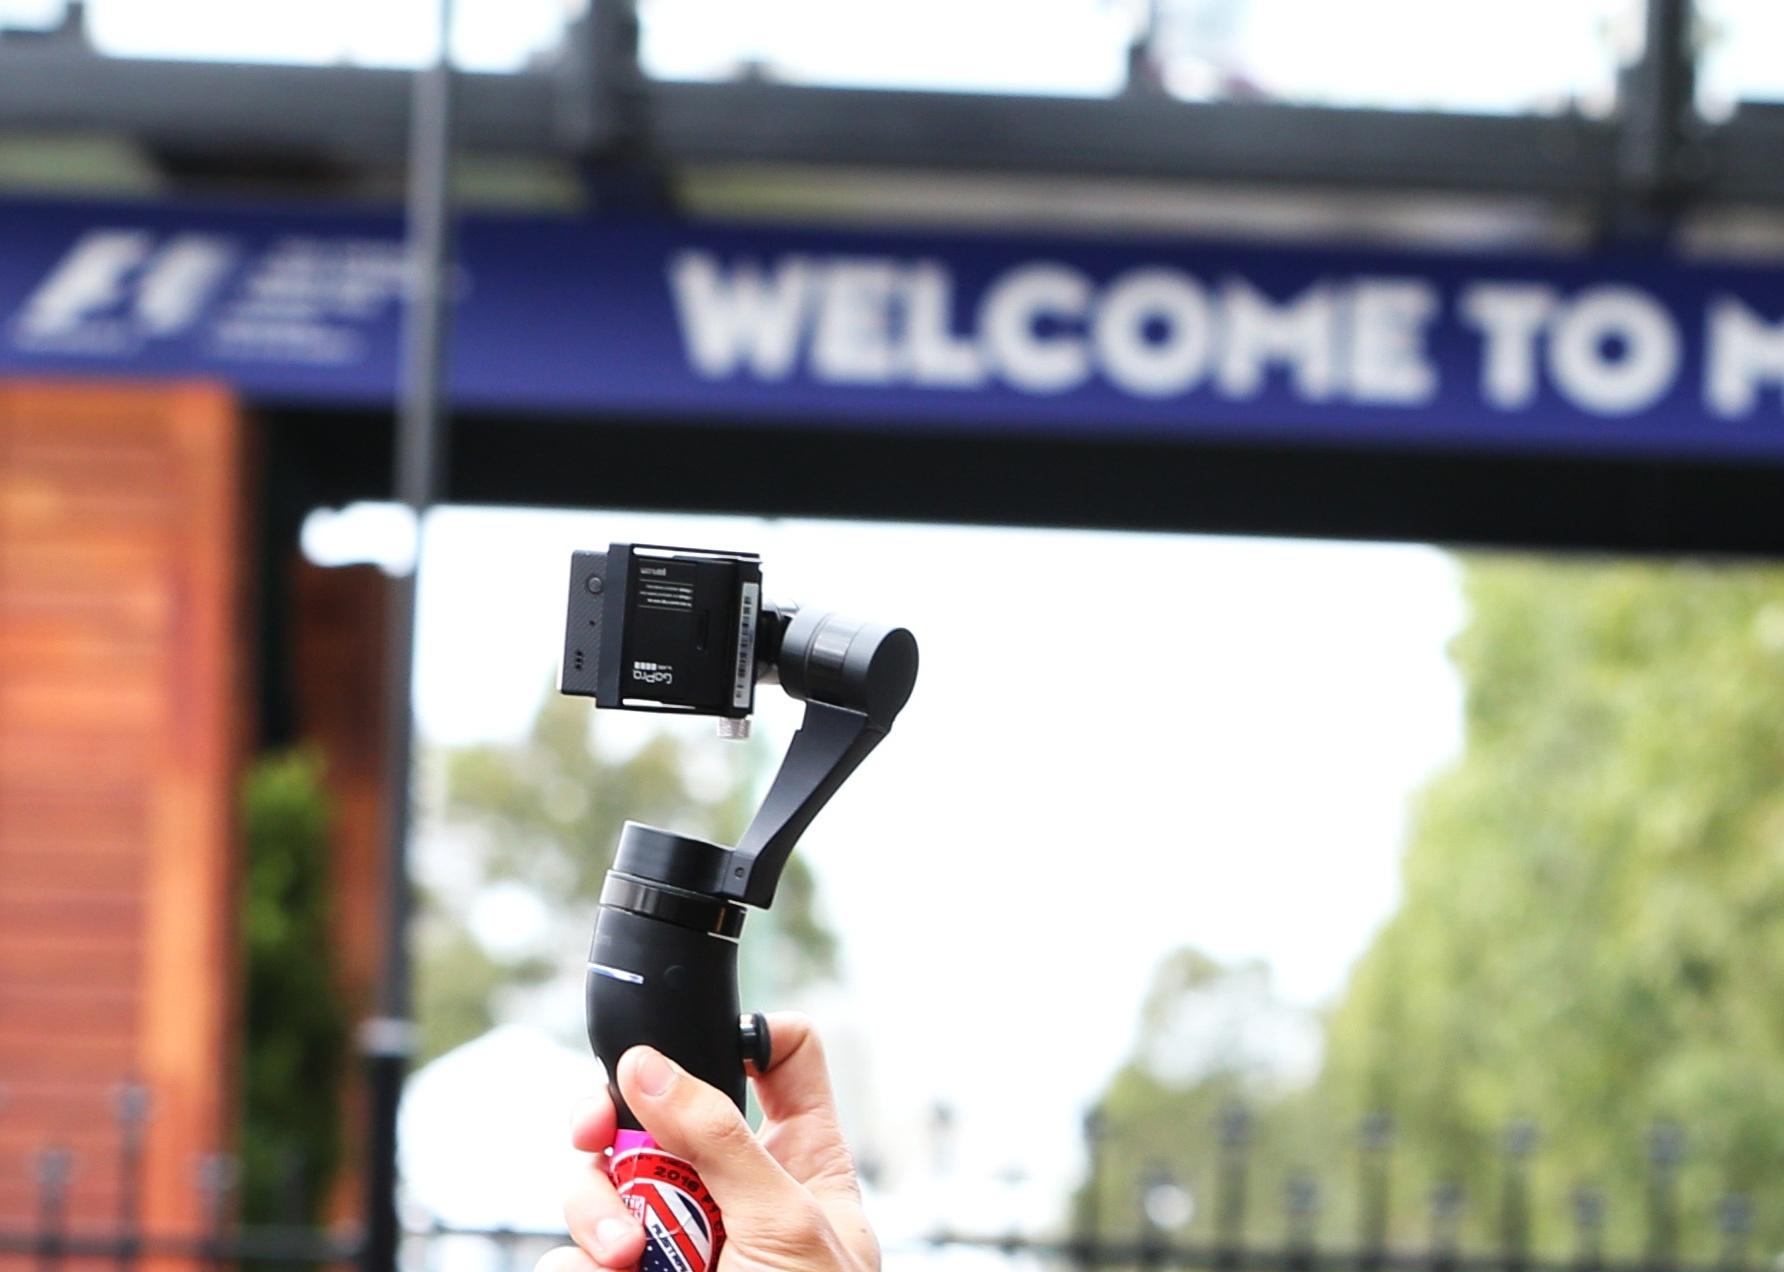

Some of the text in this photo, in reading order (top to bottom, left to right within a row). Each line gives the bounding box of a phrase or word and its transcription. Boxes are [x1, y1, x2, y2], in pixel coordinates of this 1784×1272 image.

[668, 248, 1437, 402] WELCOME
[1461, 280, 1682, 415] TO
[633, 670, 673, 685] GoPro
[654, 1165, 700, 1193] 2016
